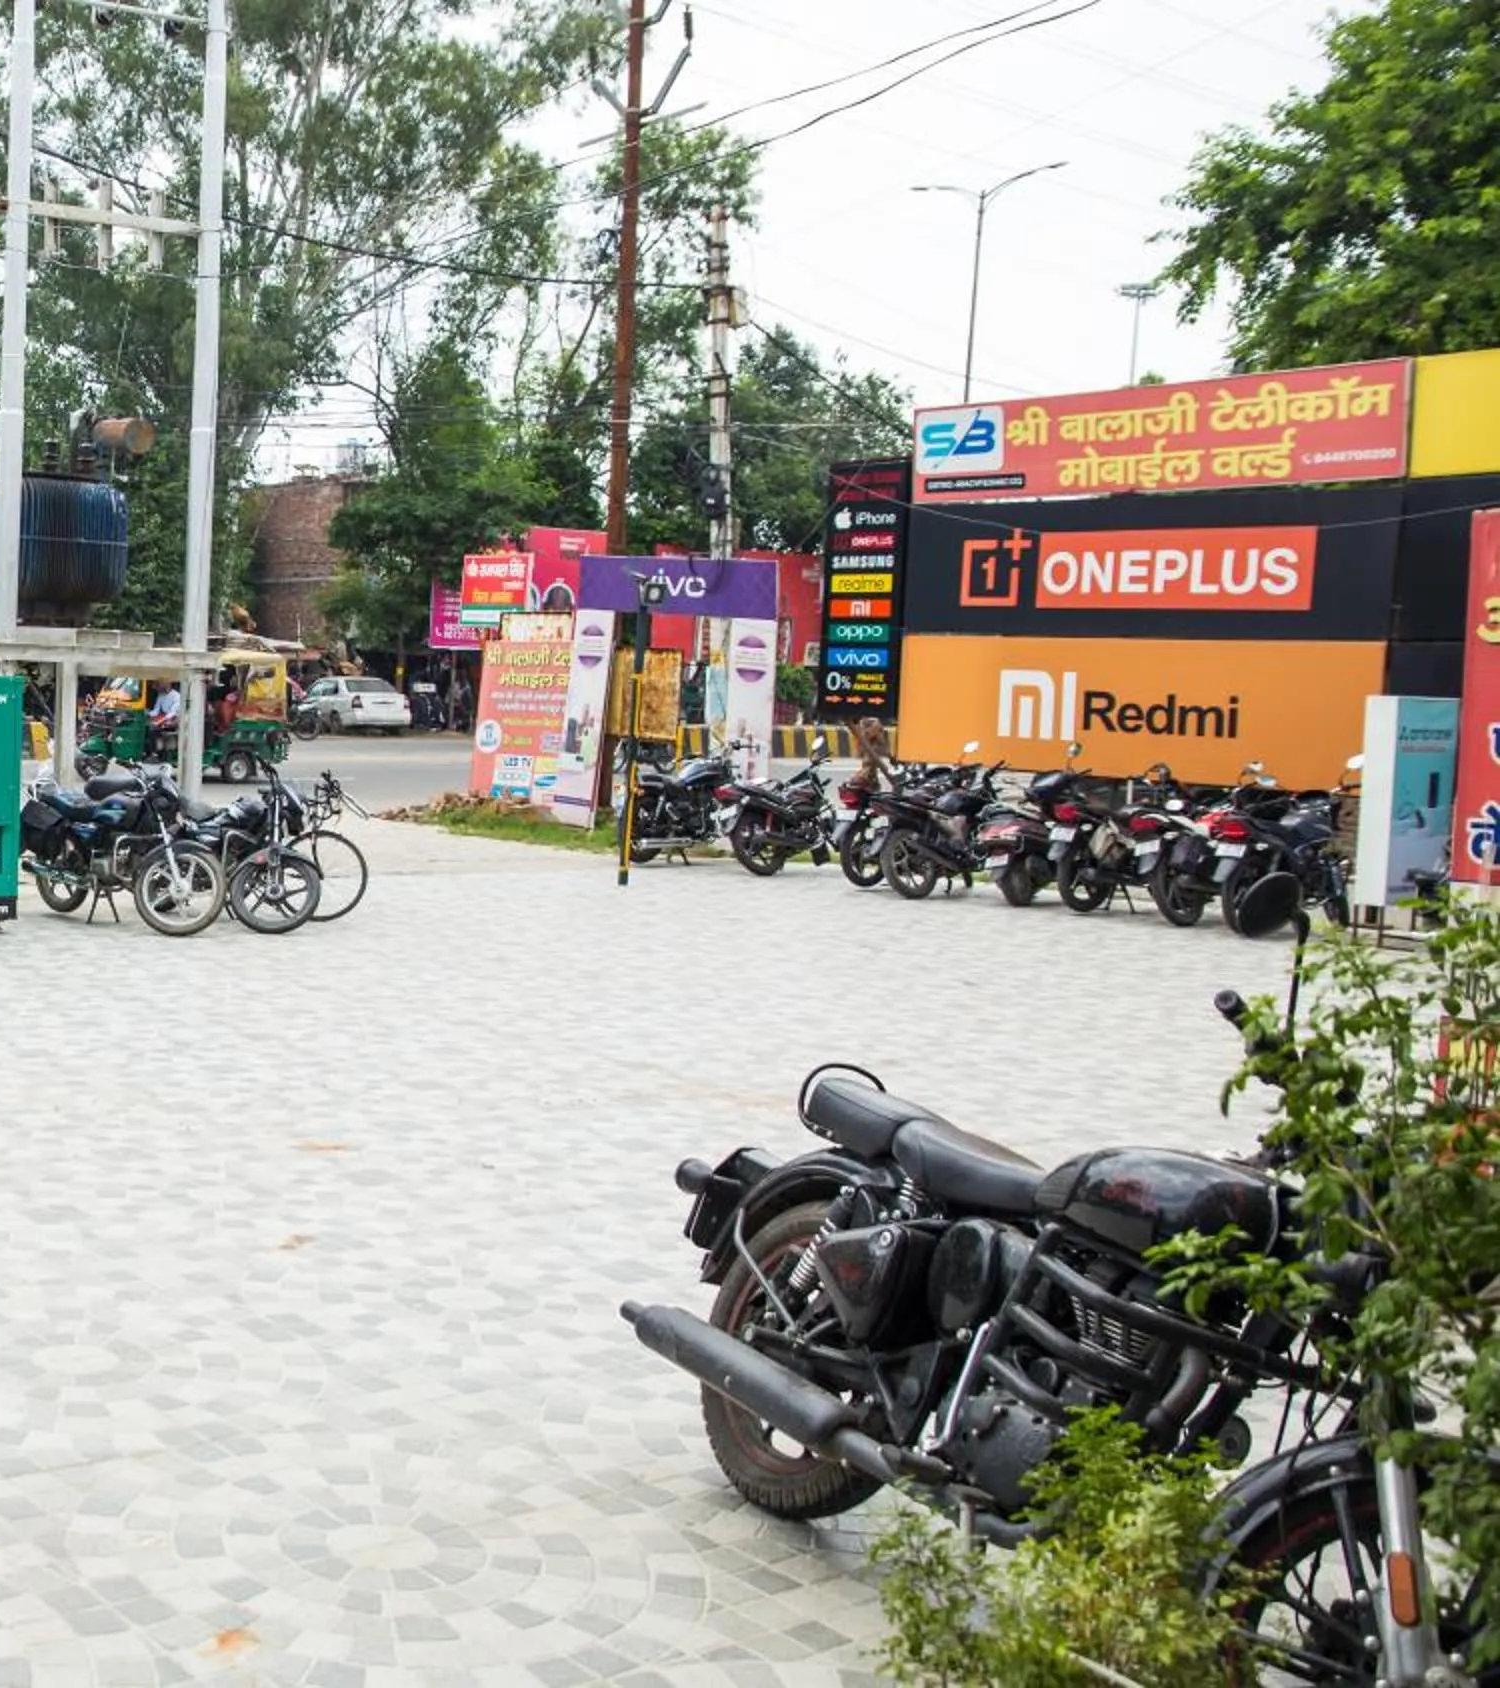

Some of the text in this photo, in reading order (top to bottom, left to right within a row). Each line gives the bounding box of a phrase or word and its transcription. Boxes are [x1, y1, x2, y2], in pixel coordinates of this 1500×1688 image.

[1005, 375, 1395, 446] श्री बालाजी टेलीकॉम
[1056, 427, 1298, 488] मोबाईल वर्ल्ड
[855, 511, 897, 525] iPhone
[831, 554, 895, 569] SAMSUNG
[1042, 547, 1299, 595] ONEPLUS
[835, 649, 881, 667] vivo
[1082, 690, 1239, 738] Redmi
